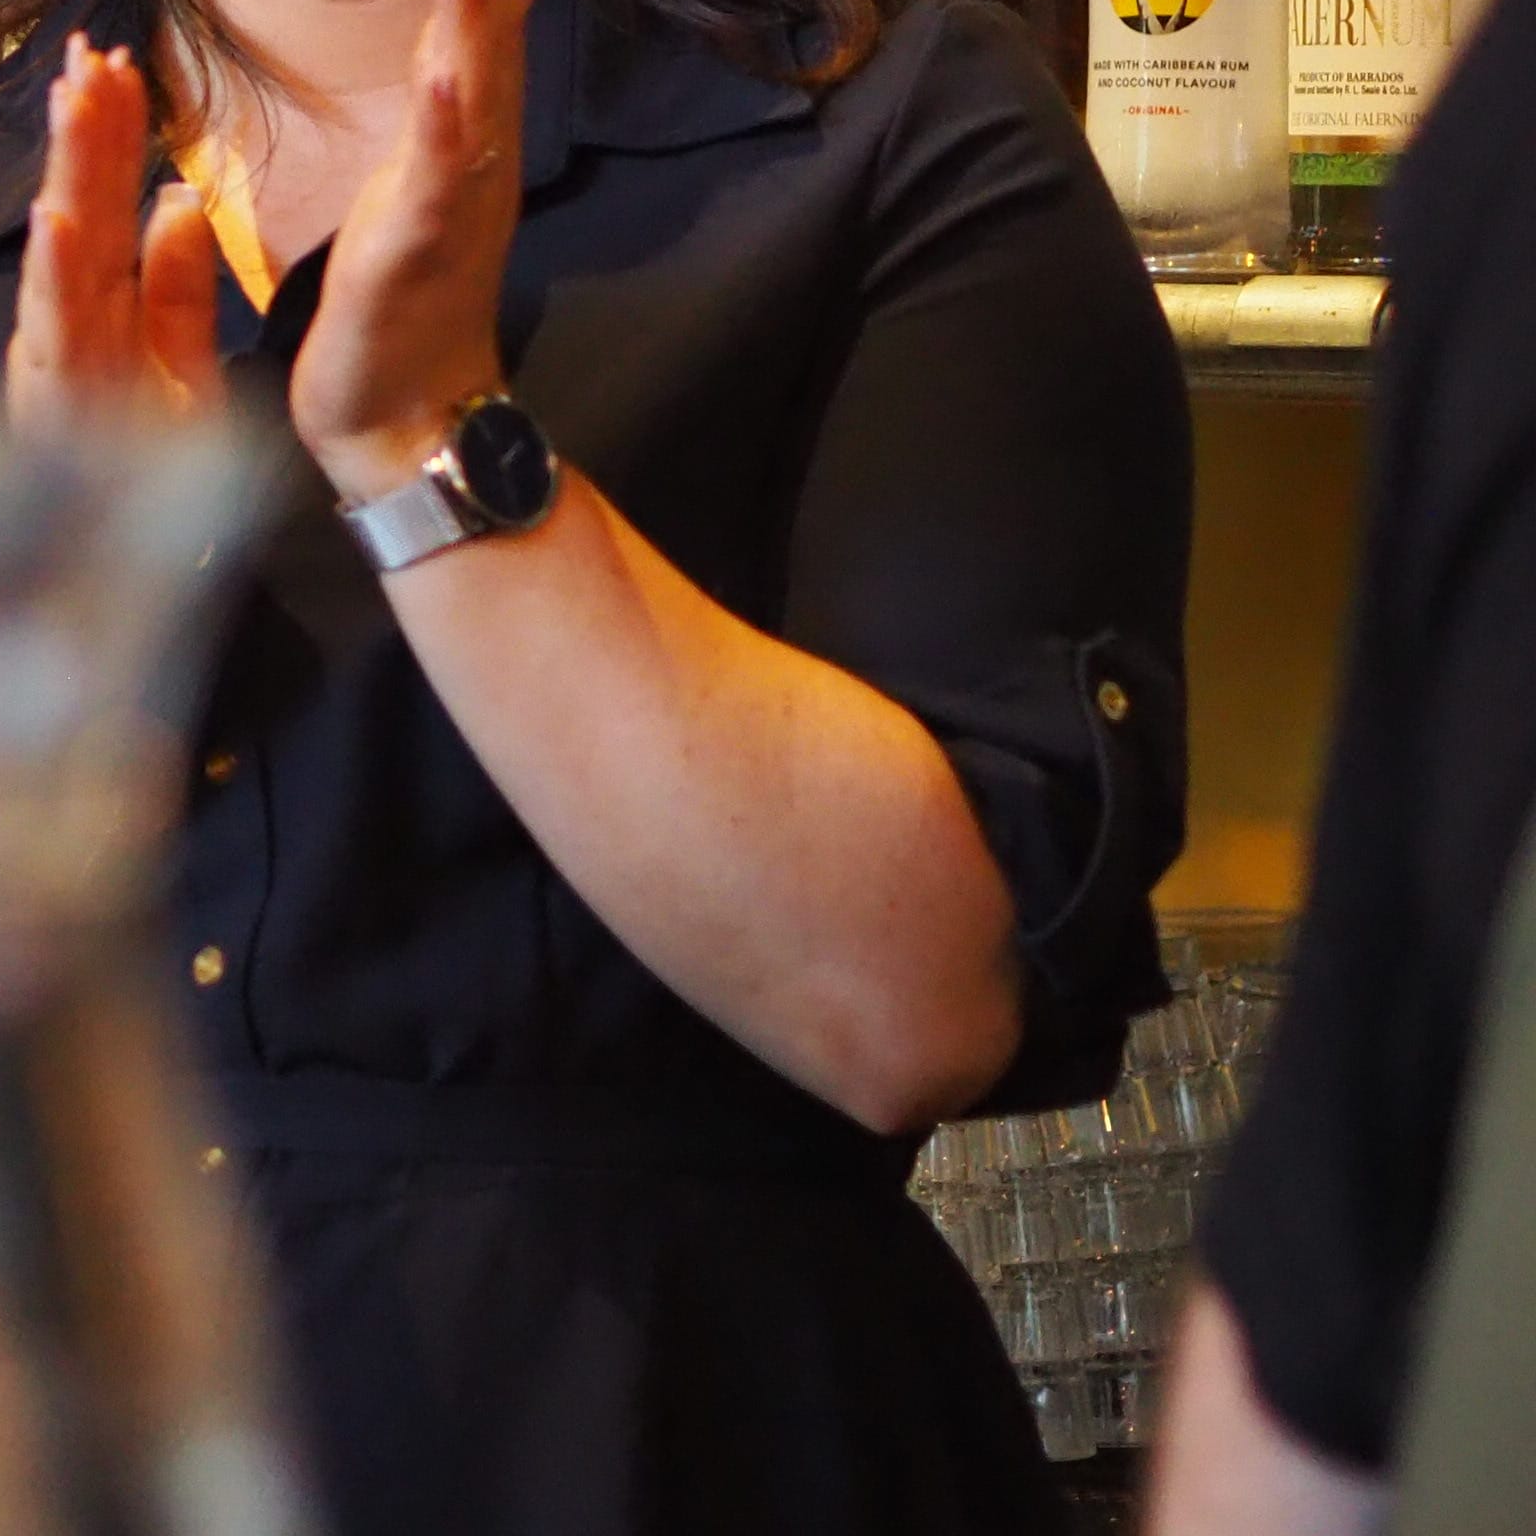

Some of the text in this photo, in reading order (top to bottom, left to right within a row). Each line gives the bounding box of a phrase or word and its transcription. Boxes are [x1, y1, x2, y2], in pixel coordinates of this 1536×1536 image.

[1114, 59, 1140, 70] WITH
[1143, 59, 1216, 72] CARIBBEAN
[1220, 60, 1250, 72] RUM
[1098, 77, 1237, 90] AND COCONUT FLAVOUR
[1332, 72, 1344, 83] OF
[1346, 71, 1405, 83] BARBADOS
